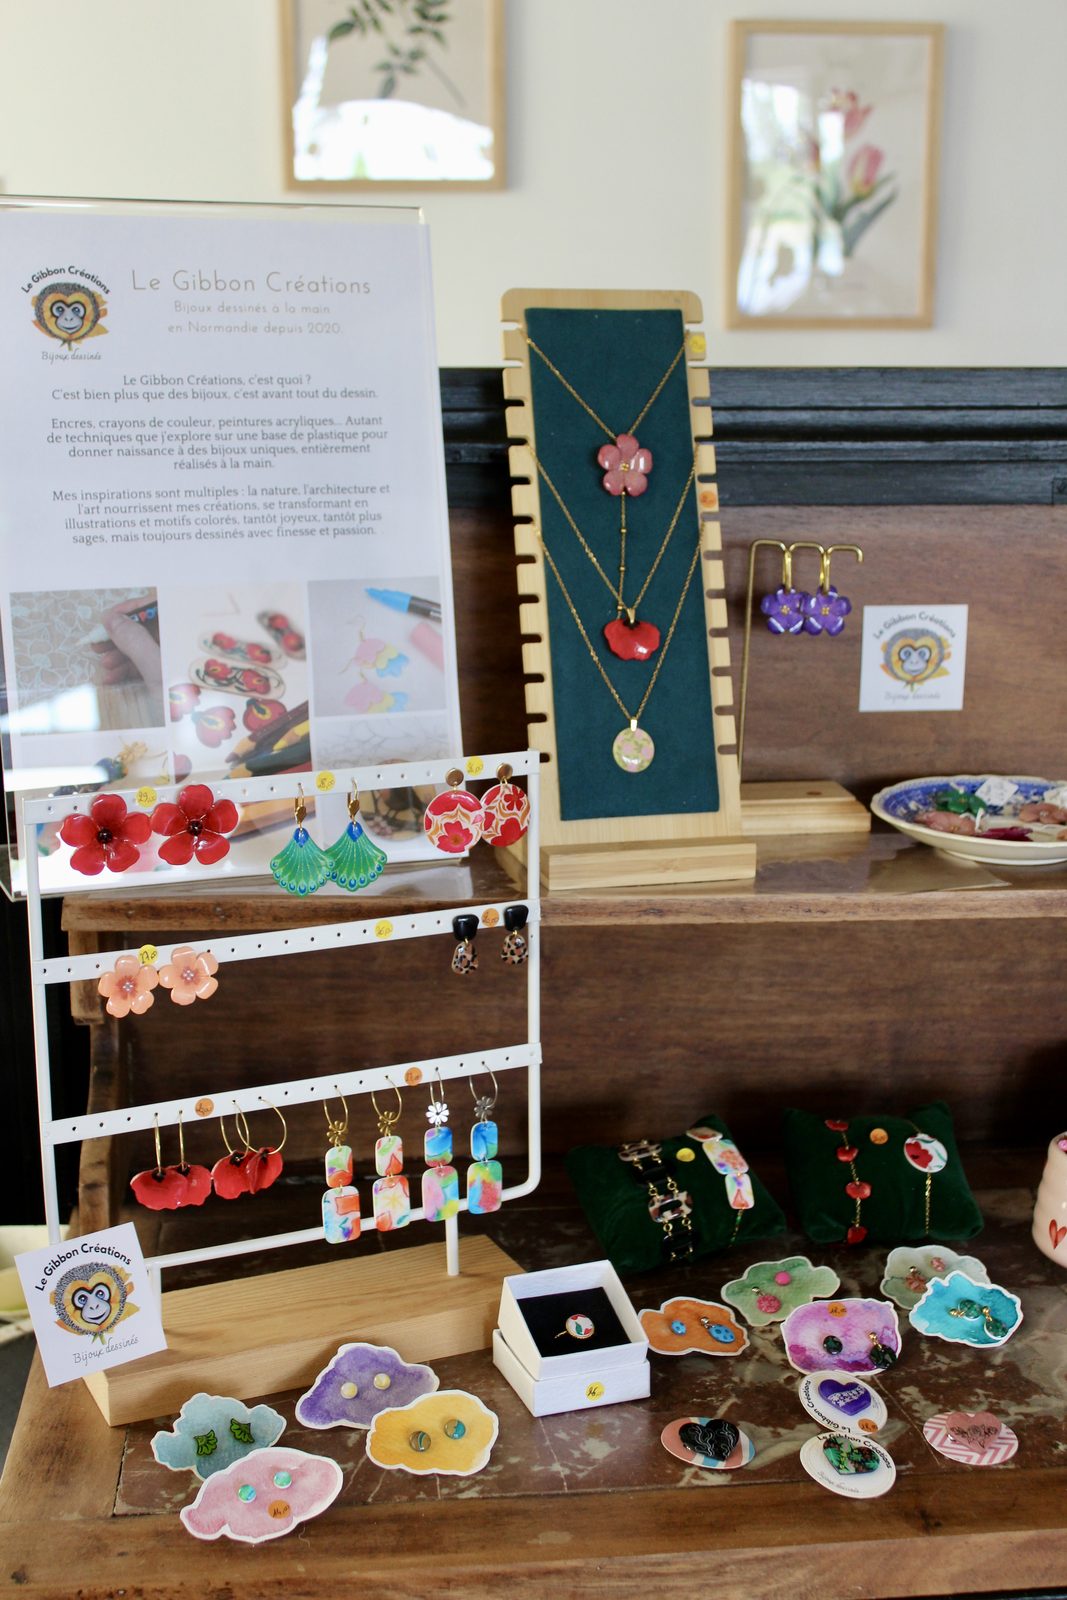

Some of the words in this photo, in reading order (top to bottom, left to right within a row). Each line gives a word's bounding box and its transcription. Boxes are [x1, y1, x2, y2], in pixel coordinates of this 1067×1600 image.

[21, 283, 33, 294] Le
[31, 267, 65, 283] Gibbon
[67, 265, 111, 295] Créations
[131, 269, 160, 290] Le
[172, 269, 255, 292] Gibbon
[265, 271, 371, 294] Créations
[173, 300, 212, 314] Bijoux
[217, 300, 267, 314] dessinés
[271, 302, 280, 313] à
[284, 301, 296, 313] la
[300, 304, 331, 314] main
[167, 323, 182, 333] en
[188, 320, 258, 334] Normandie
[263, 321, 303, 337] depuis
[307, 322, 343, 334] 2020.
[41, 351, 70, 365] Bijoux
[70, 347, 101, 360] dessinés
[123, 375, 137, 386] Le
[140, 375, 184, 386] Gibbon
[187, 375, 246, 387] Créations,
[248, 375, 274, 385] c'est
[276, 375, 303, 388] quoi
[305, 375, 311, 385] ?
[52, 389, 80, 400] C'est
[84, 389, 110, 400] bien
[114, 389, 139, 403] plus
[142, 391, 165, 402] que
[168, 389, 188, 400] des
[191, 389, 231, 401] bijoux,
[234, 389, 259, 399] c'est
[262, 390, 293, 399] avant
[296, 390, 319, 399] tout
[322, 388, 338, 398] du
[340, 388, 379, 398] dessin.
[52, 418, 96, 430] Encres,
[98, 419, 146, 431] crayons
[149, 416, 164, 428] de
[166, 416, 215, 429] couleur,
[219, 416, 273, 430] peintures
[345, 416, 383, 426] Autant
[47, 432, 62, 443] de
[65, 431, 132, 445] techniques
[135, 433, 158, 446] que
[161, 431, 212, 444] j'explore
[214, 432, 233, 441] sur
[237, 432, 258, 440] une
[261, 430, 287, 441] base
[290, 429, 306, 440] de
[307, 429, 359, 442] plastique
[361, 430, 388, 442] pour
[68, 447, 113, 457] donner
[117, 446, 174, 456] naissance
[177, 445, 185, 455] à
[187, 445, 208, 455] des
[211, 444, 246, 456] bijoux
[250, 444, 299, 457] uniques,
[301, 443, 371, 454] entièrement
[174, 458, 218, 470] réalisés
[220, 459, 227, 469] à
[230, 458, 240, 468] la
[243, 458, 275, 468] main.
[52, 490, 77, 501] Mes
[81, 489, 151, 503] inspirations
[155, 488, 180, 499] sont
[184, 486, 239, 500] multiples
[248, 485, 257, 496] la
[261, 486, 301, 496] nature,
[304, 484, 377, 495] l'architecture
[379, 484, 390, 494] et
[78, 503, 100, 515] l'art
[104, 502, 173, 514] nourrissent
[176, 503, 200, 512] mes
[203, 501, 260, 511] créations,
[263, 501, 275, 510] se
[278, 498, 350, 510] transformant
[354, 499, 368, 508] en
[65, 517, 136, 530] illustrations
[139, 516, 151, 528] et
[154, 515, 191, 527] motifs
[194, 514, 240, 526] colorés,
[243, 512, 277, 524] tantôt
[280, 512, 320, 525] joyeux,
[323, 511, 356, 522] tantôt
[358, 510, 382, 524] plus
[72, 534, 108, 547] sages,
[111, 532, 139, 543] mais
[142, 530, 192, 543] toujours
[195, 528, 244, 540] dessinés
[247, 528, 273, 538] avec
[276, 526, 316, 537] finesse
[319, 526, 329, 536] et
[332, 525, 376, 538] passion.
[35, 1277, 48, 1292] Le
[43, 1248, 79, 1277] Gibbon
[81, 1243, 132, 1266] Créations
[72, 1350, 106, 1367] Bijoux
[105, 1334, 140, 1353] dessinés
[814, 1408, 840, 1429] Gibbon
[841, 1426, 851, 1434] Le
[863, 1440, 892, 1469] Créations
